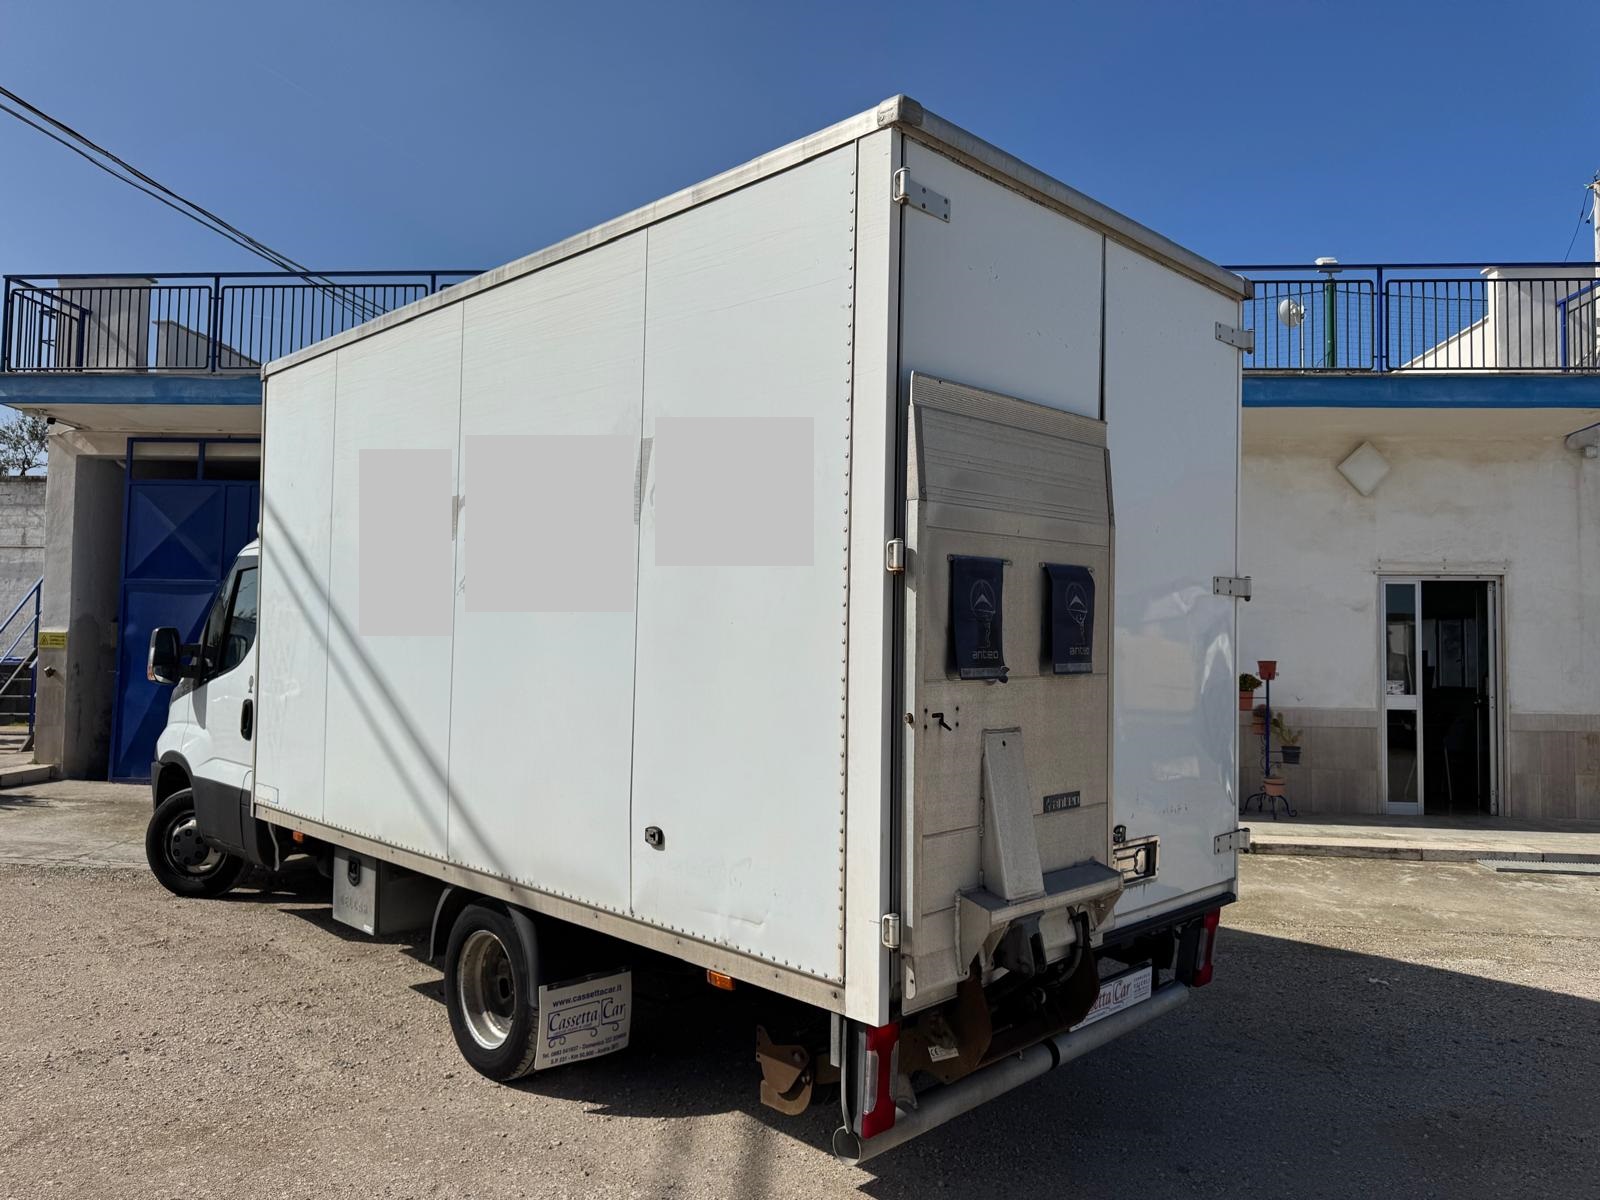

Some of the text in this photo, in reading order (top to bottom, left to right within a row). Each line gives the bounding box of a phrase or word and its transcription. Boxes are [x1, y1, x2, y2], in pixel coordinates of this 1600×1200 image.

[972, 650, 999, 660] anteo
[552, 984, 622, 1008] www.cassettacar.it
[1114, 981, 1132, 1002] Car
[549, 1010, 598, 1032] Cassetta
[603, 1000, 626, 1019] Car
